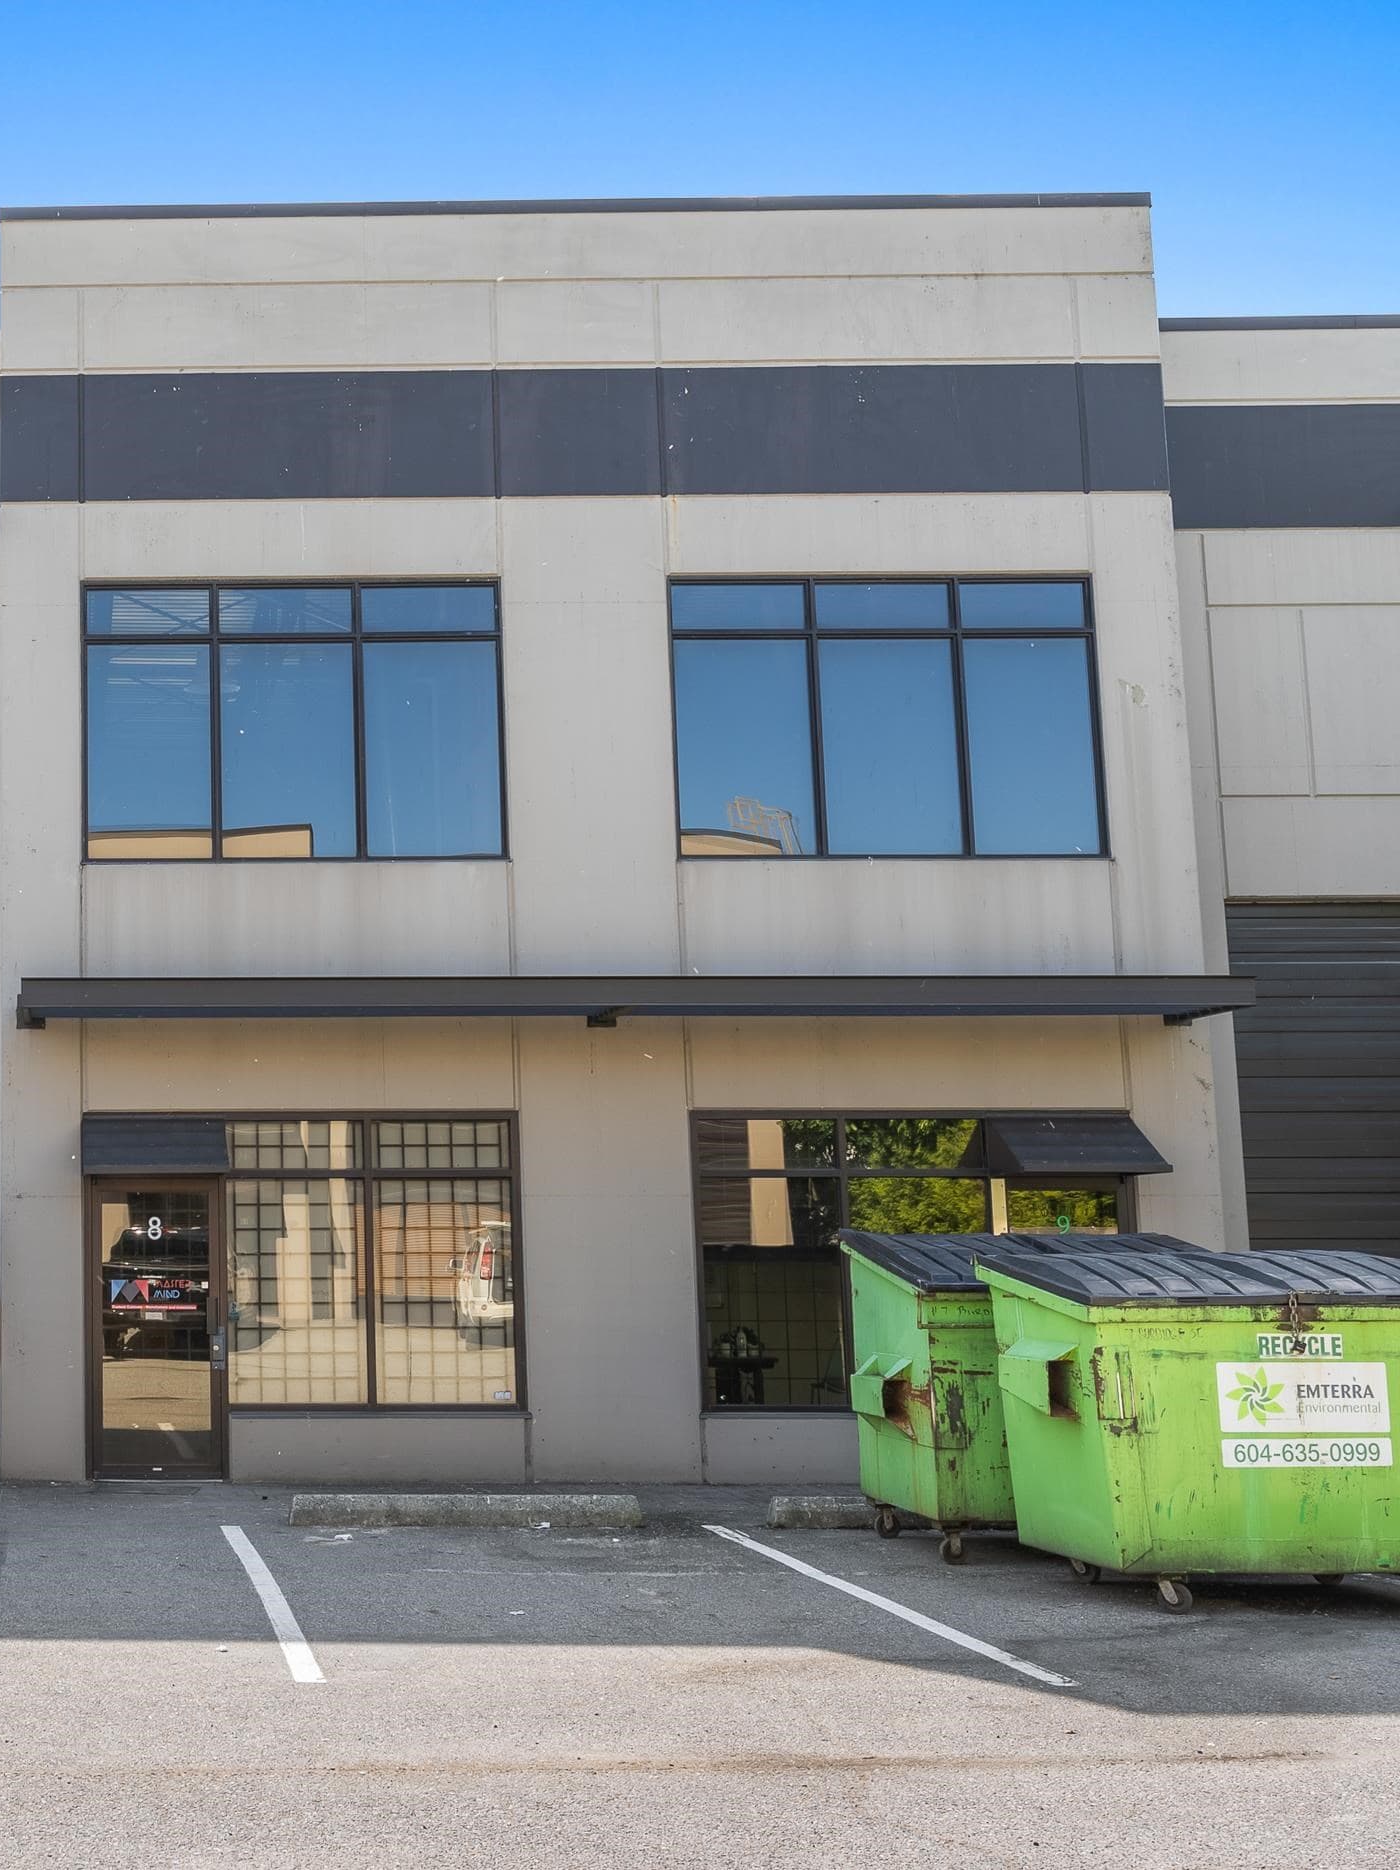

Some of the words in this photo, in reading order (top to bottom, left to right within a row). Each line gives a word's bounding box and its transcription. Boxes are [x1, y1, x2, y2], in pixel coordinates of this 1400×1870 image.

[147, 1216, 162, 1241] 8
[1057, 1215, 1070, 1235] 9
[153, 1289, 181, 1299] MIND
[1296, 1384, 1375, 1399] EMTERRA
[1297, 1402, 1381, 1415] Environmental
[1233, 1442, 1381, 1463] 604-635-0999
